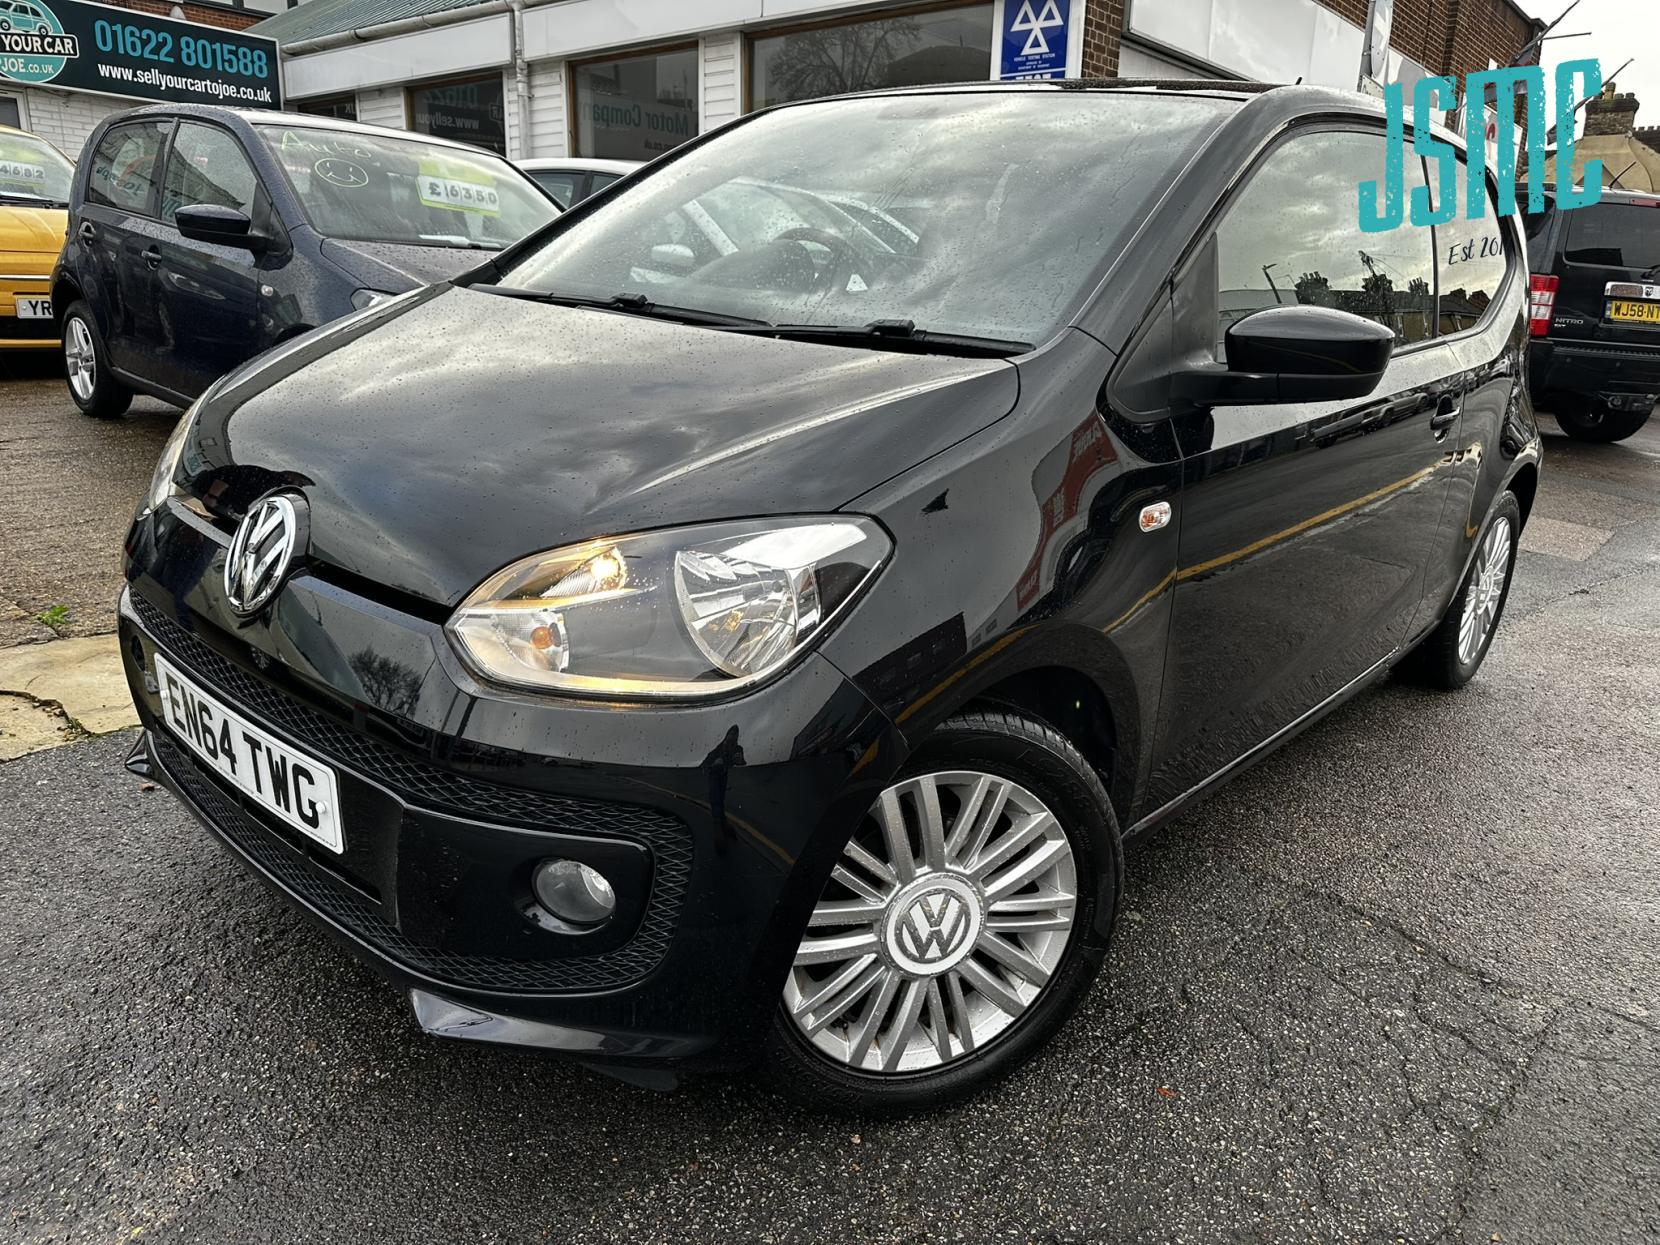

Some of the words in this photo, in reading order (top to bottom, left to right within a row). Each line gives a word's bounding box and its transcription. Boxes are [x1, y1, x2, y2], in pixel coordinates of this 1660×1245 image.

[1, 34, 43, 53] YOUR
[44, 37, 75, 54] CAR
[94, 20, 174, 63] 01622
[180, 36, 269, 79] 801588
[98, 63, 272, 103] www.sellyourcartojoe.co.uk
[28, 300, 52, 316] YR
[1614, 303, 1645, 317] WJ58
[165, 672, 237, 776] EN64
[242, 730, 319, 829] TWG
